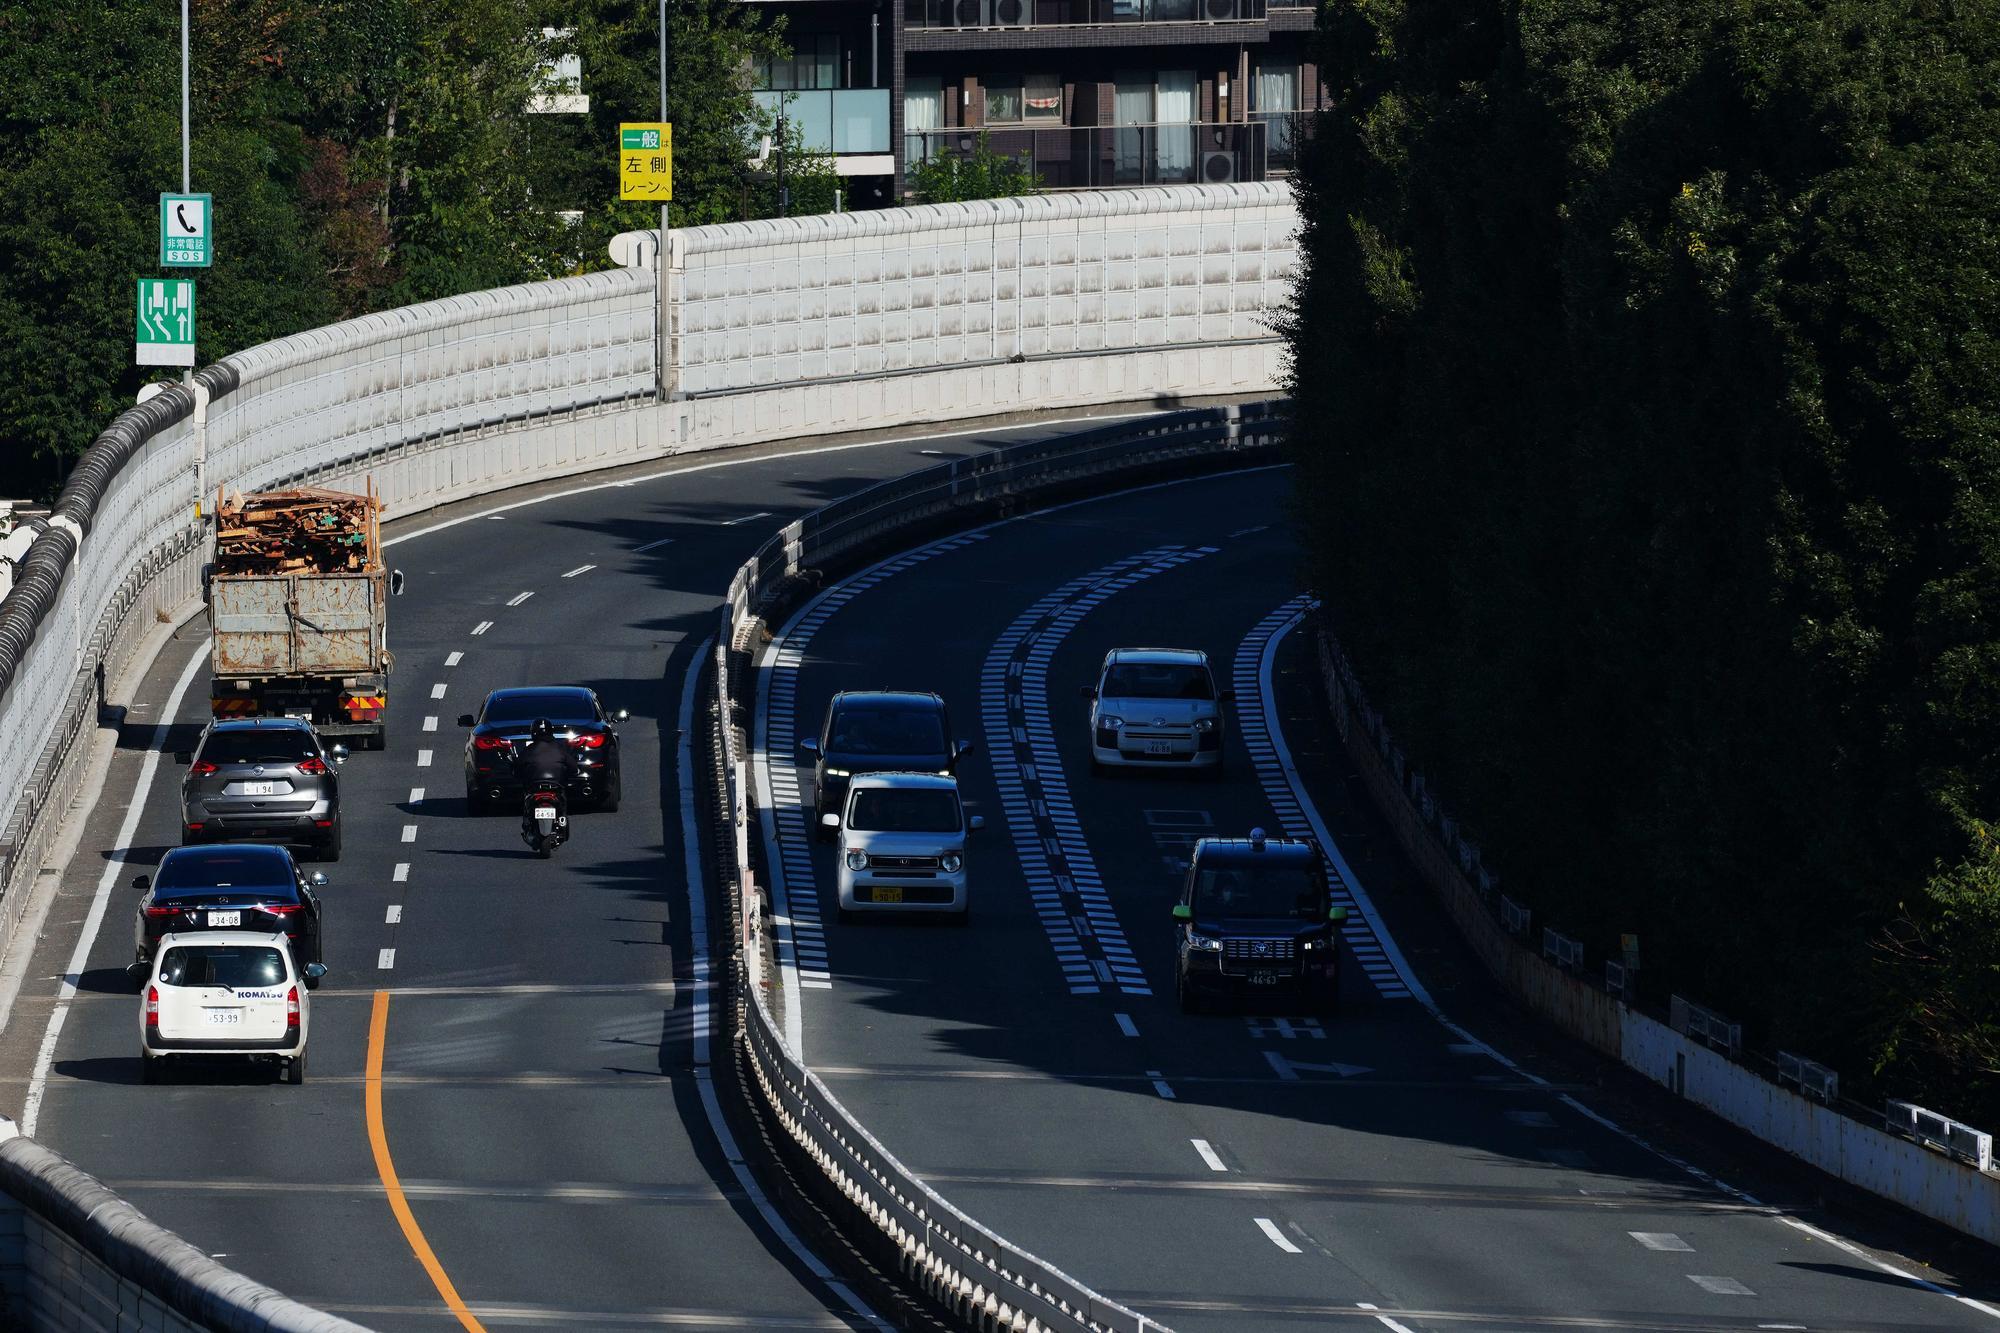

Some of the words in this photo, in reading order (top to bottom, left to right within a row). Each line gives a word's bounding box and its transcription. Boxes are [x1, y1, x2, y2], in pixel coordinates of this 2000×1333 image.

[625, 156, 667, 174] 左側
[623, 181, 670, 194] レーンへ
[167, 238, 204, 250] 非常電話
[172, 252, 200, 261] SOS
[216, 916, 239, 925] 34-08
[237, 991, 284, 999] KOMATSU
[213, 1014, 238, 1023] 53-99
